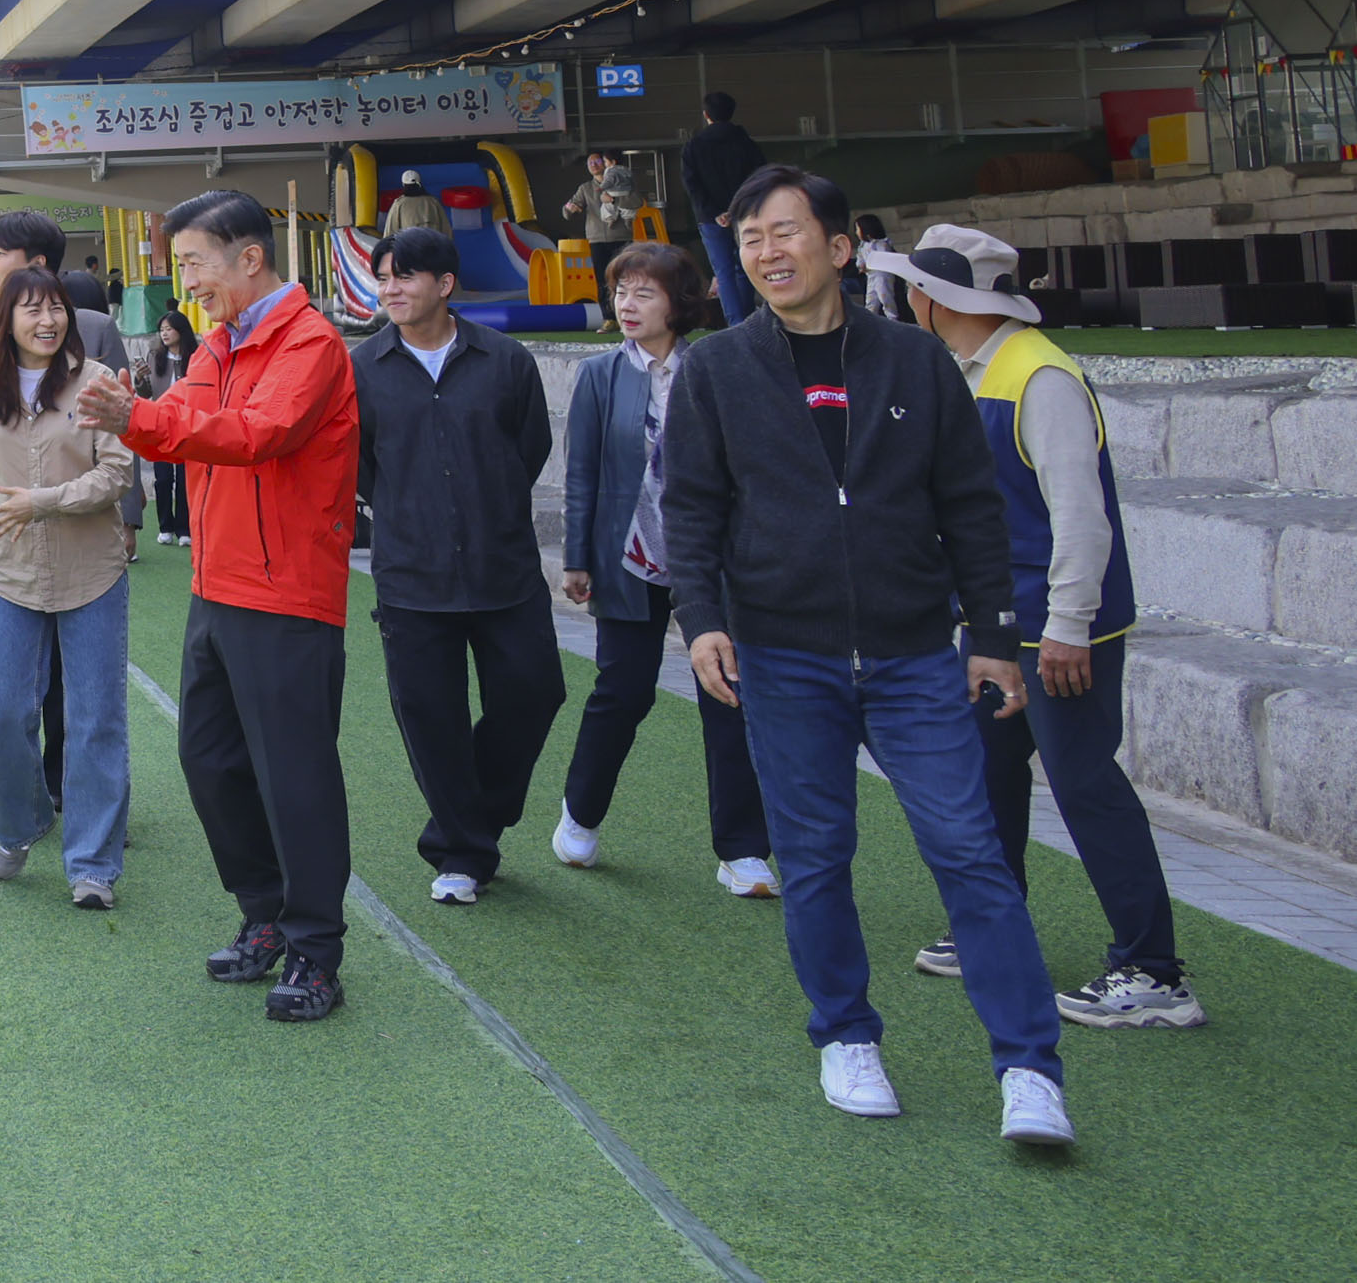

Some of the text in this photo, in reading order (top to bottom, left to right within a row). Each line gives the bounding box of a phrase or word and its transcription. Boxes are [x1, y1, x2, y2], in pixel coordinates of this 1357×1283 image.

[95, 89, 489, 135] 조심조심 즐겁고 안전한 놀이터 이용!
[53, 206, 93, 223] 없는지
